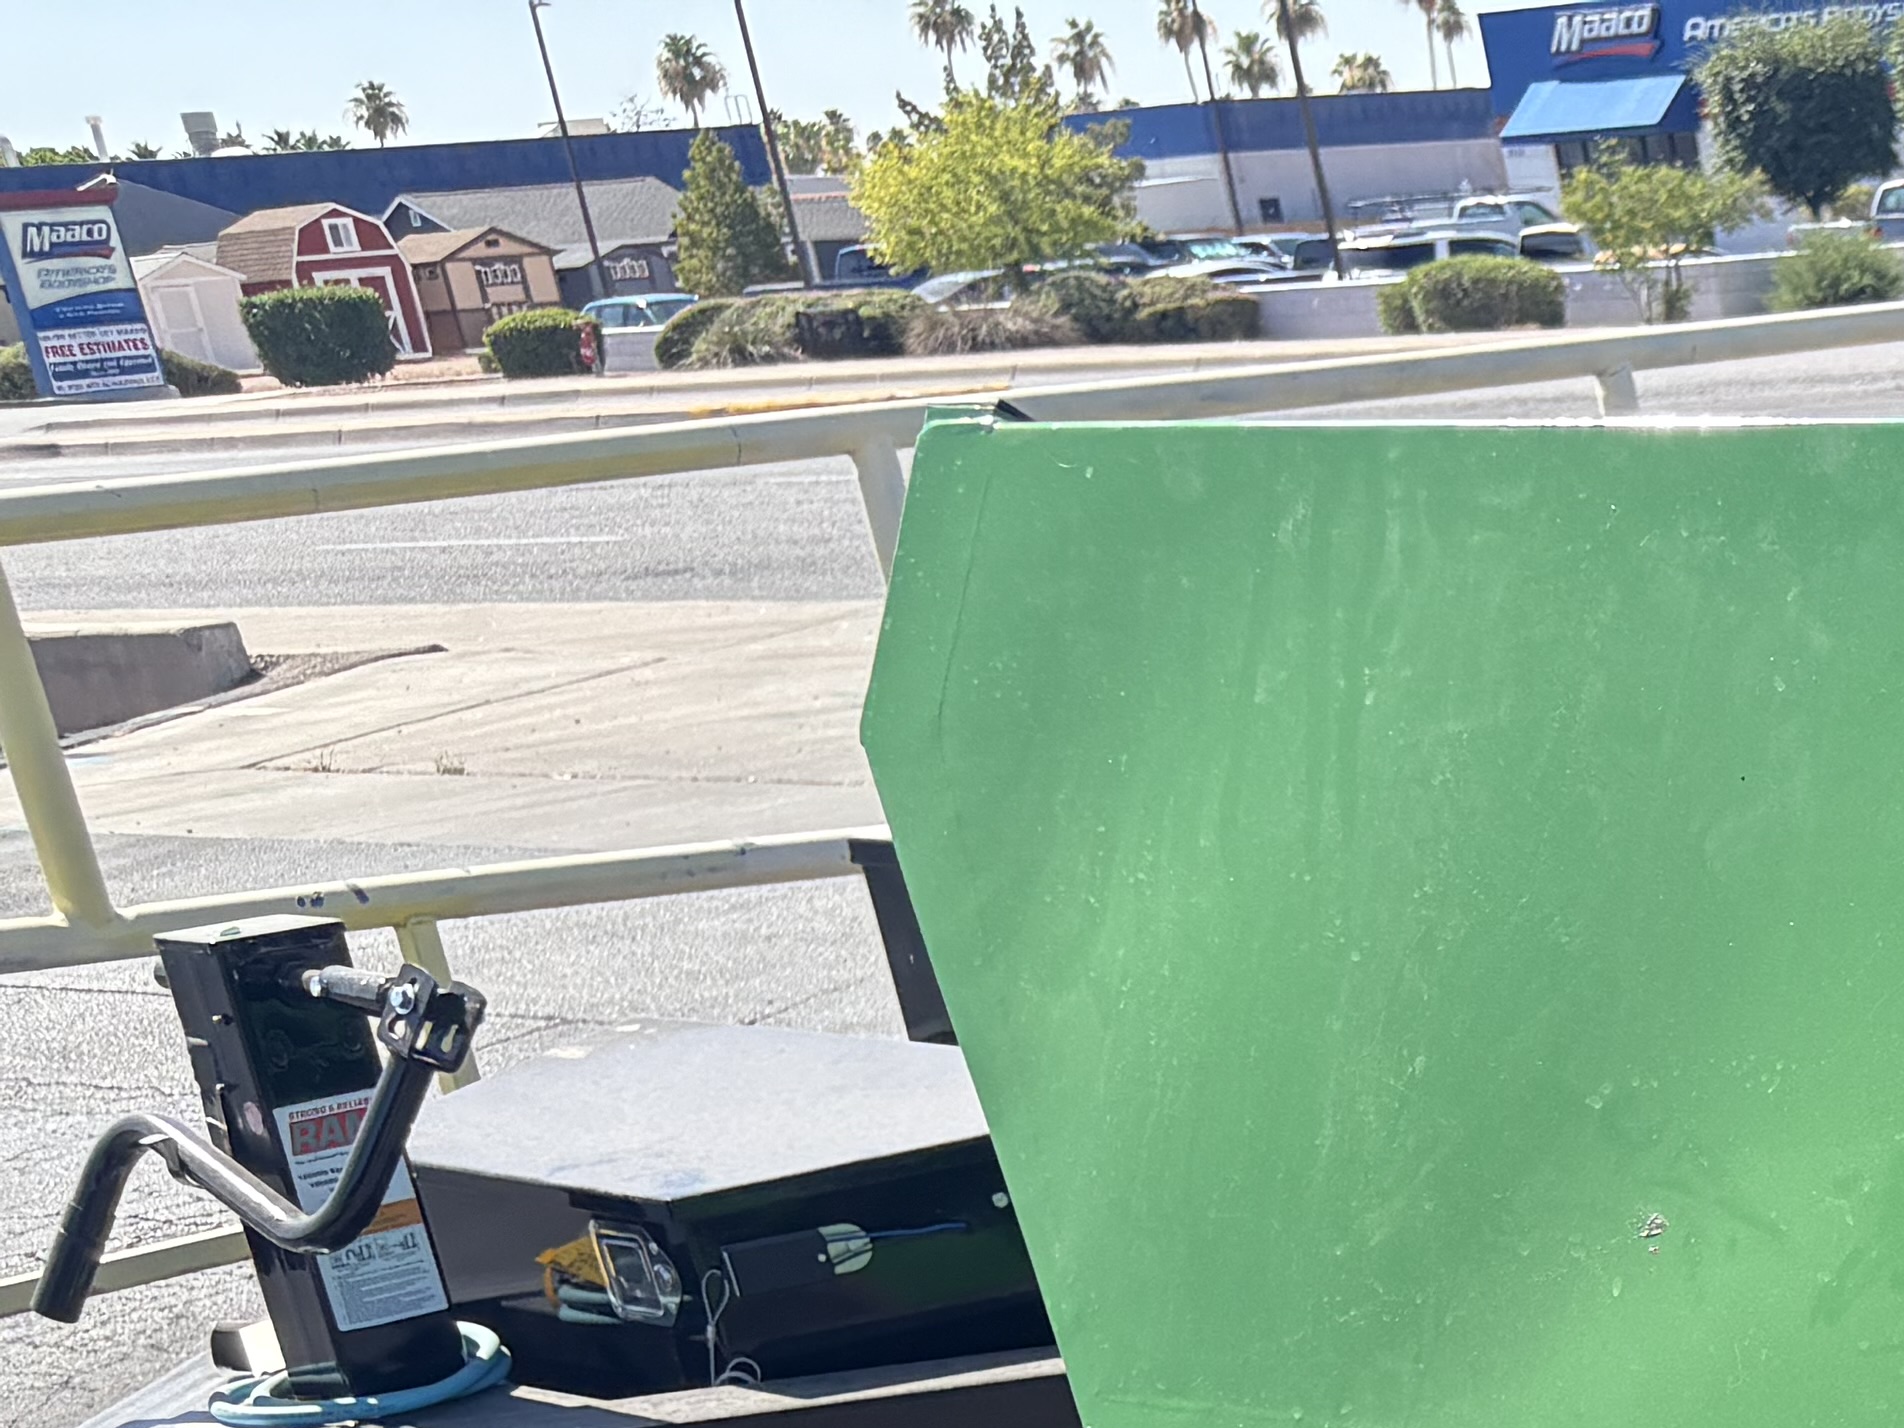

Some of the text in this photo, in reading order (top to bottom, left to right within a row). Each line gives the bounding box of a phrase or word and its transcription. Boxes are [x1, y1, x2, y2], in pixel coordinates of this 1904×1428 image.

[1550, 7, 1655, 54] Maaco
[27, 223, 108, 253] Maaco
[45, 337, 150, 359] FREE ESTIMATES
